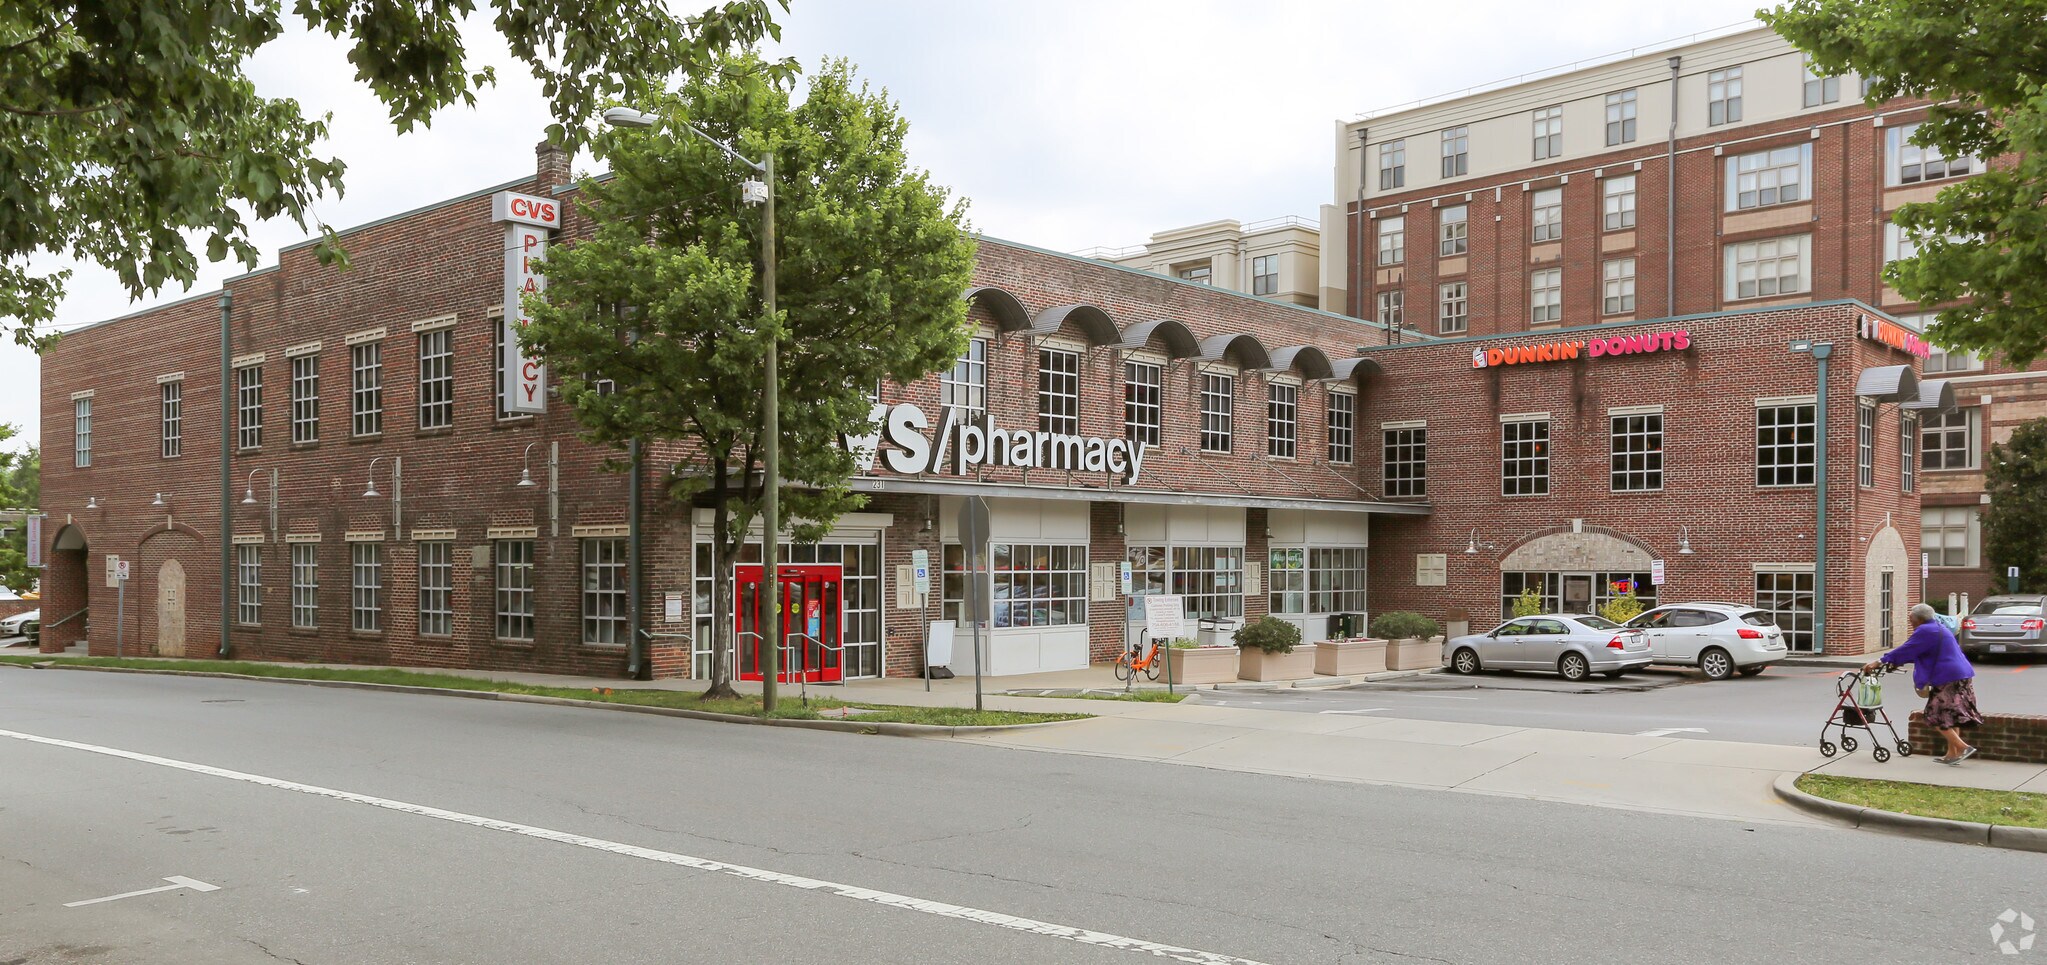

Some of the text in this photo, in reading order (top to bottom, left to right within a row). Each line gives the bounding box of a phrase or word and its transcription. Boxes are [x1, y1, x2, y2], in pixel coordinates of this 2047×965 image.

[510, 198, 556, 222] CVS
[522, 234, 539, 402] PACY
[1487, 330, 1690, 367] DUNKIN' DONUTS
[872, 480, 885, 490] 231
